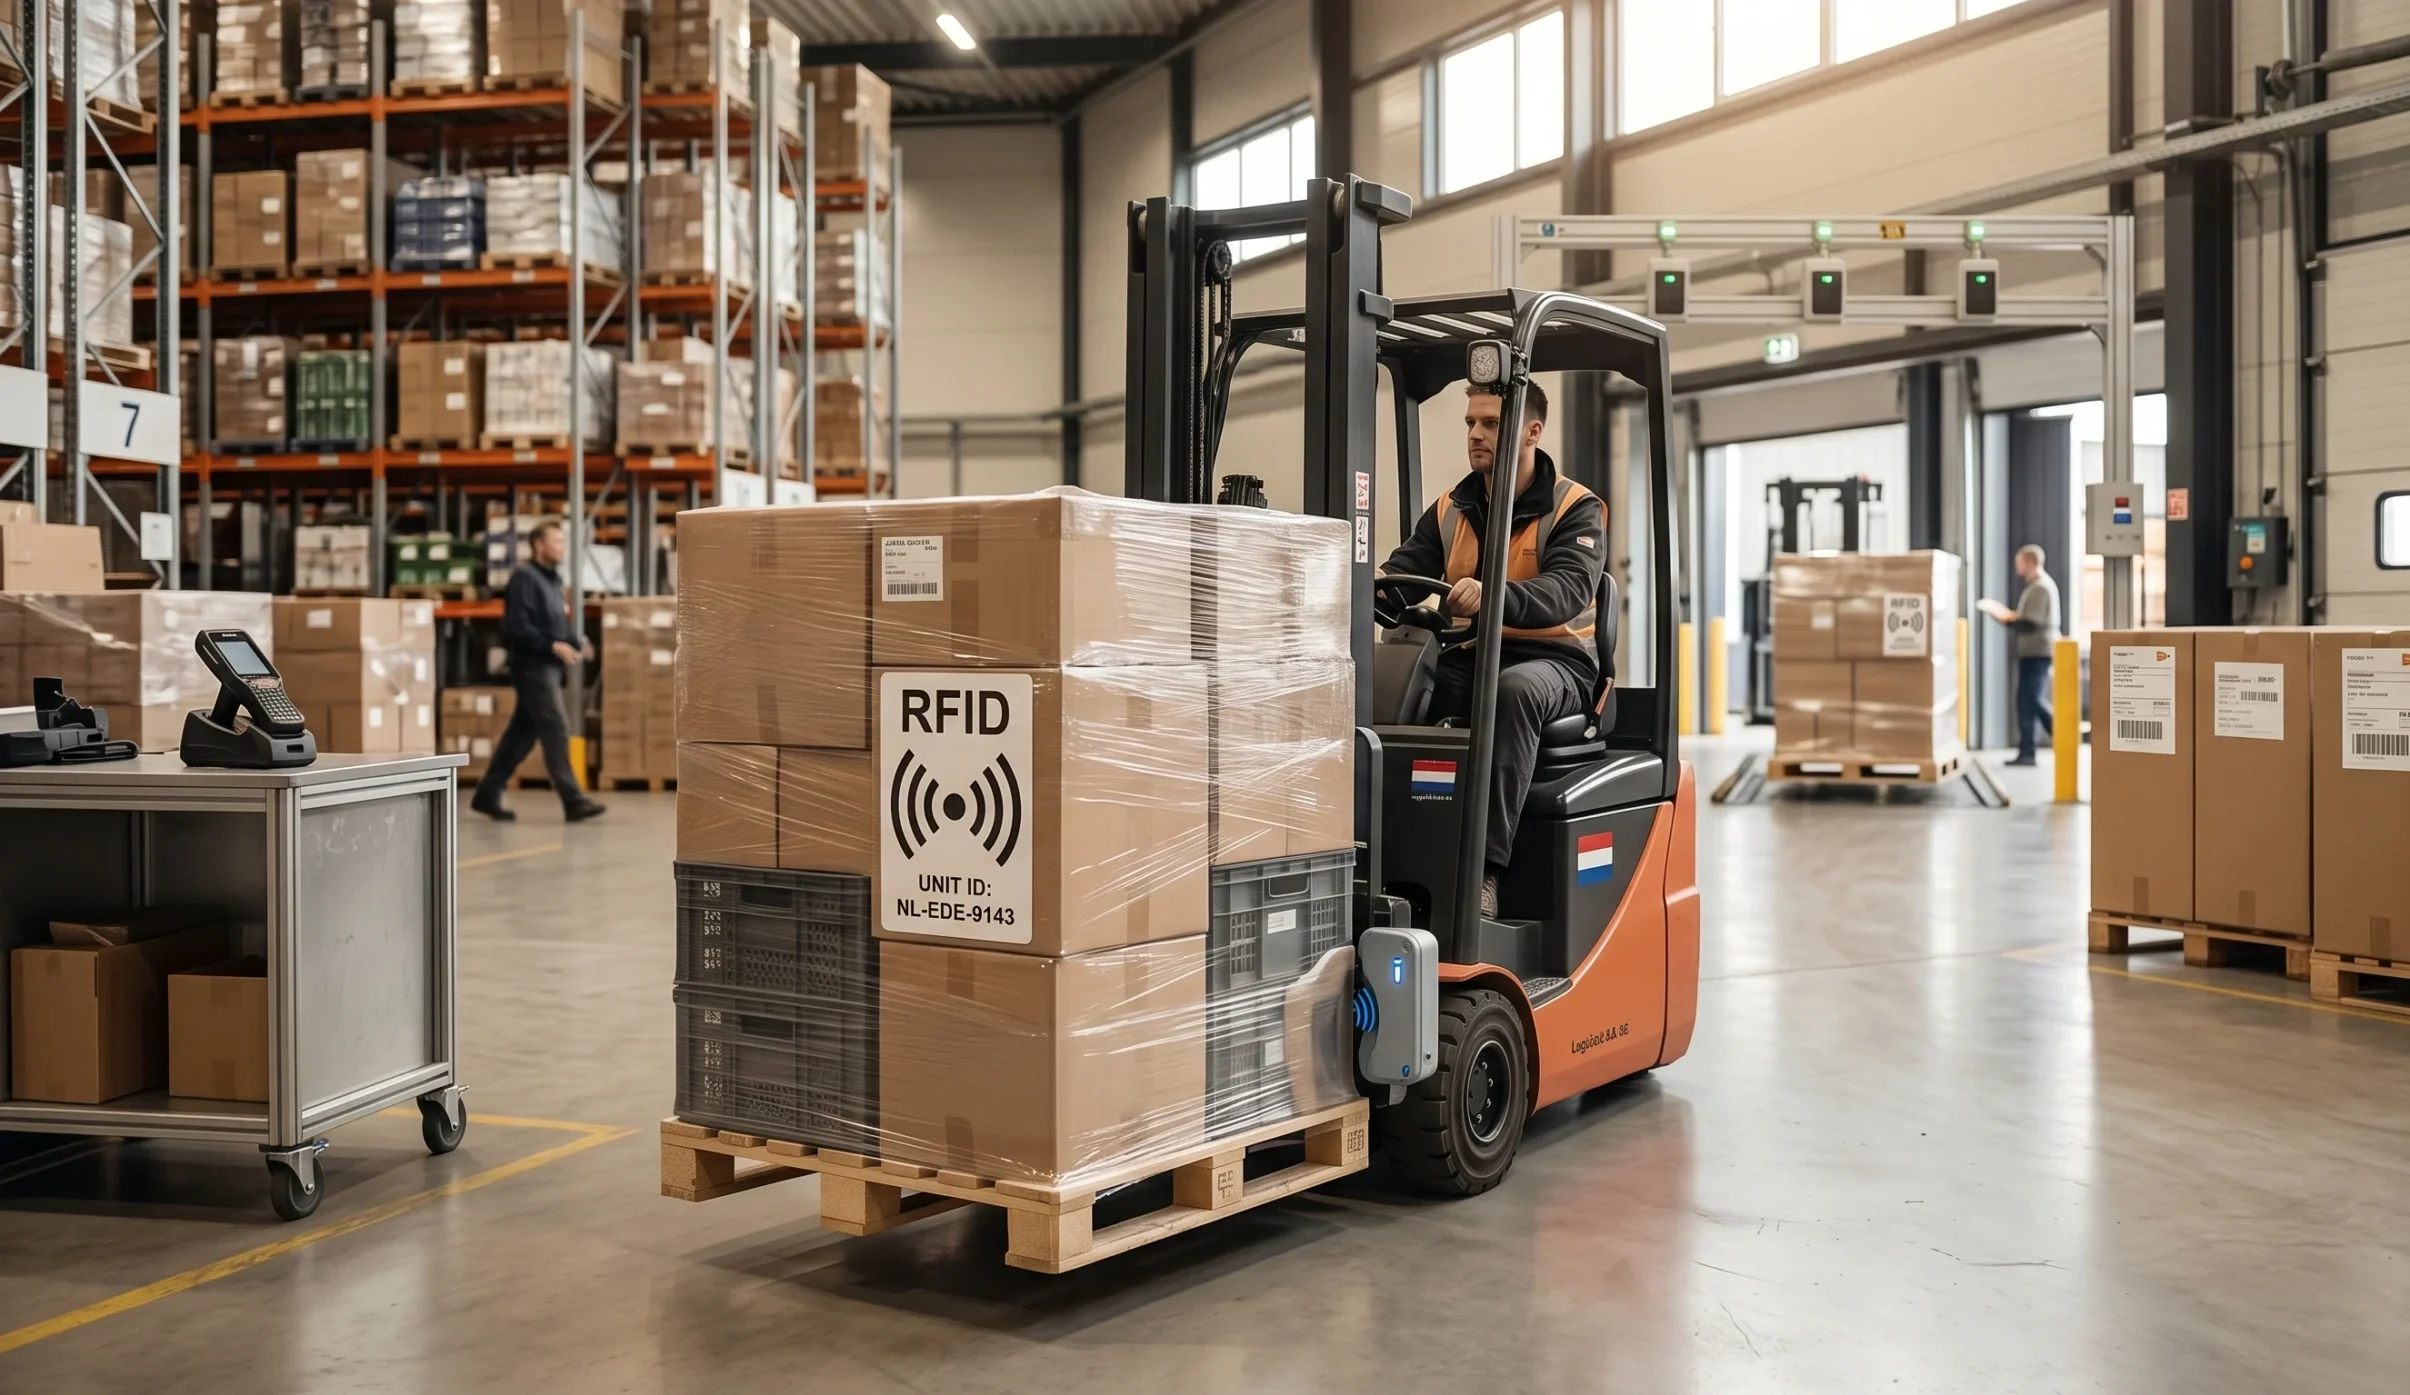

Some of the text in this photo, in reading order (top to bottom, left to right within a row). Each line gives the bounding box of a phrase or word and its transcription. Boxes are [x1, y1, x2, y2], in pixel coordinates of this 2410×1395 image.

[121, 402, 140, 447] 7
[1891, 597, 1920, 609] RFID
[902, 689, 1010, 735] RFID
[918, 874, 992, 896] UNIT ID:
[897, 899, 1015, 926] NL-EDE-9143
